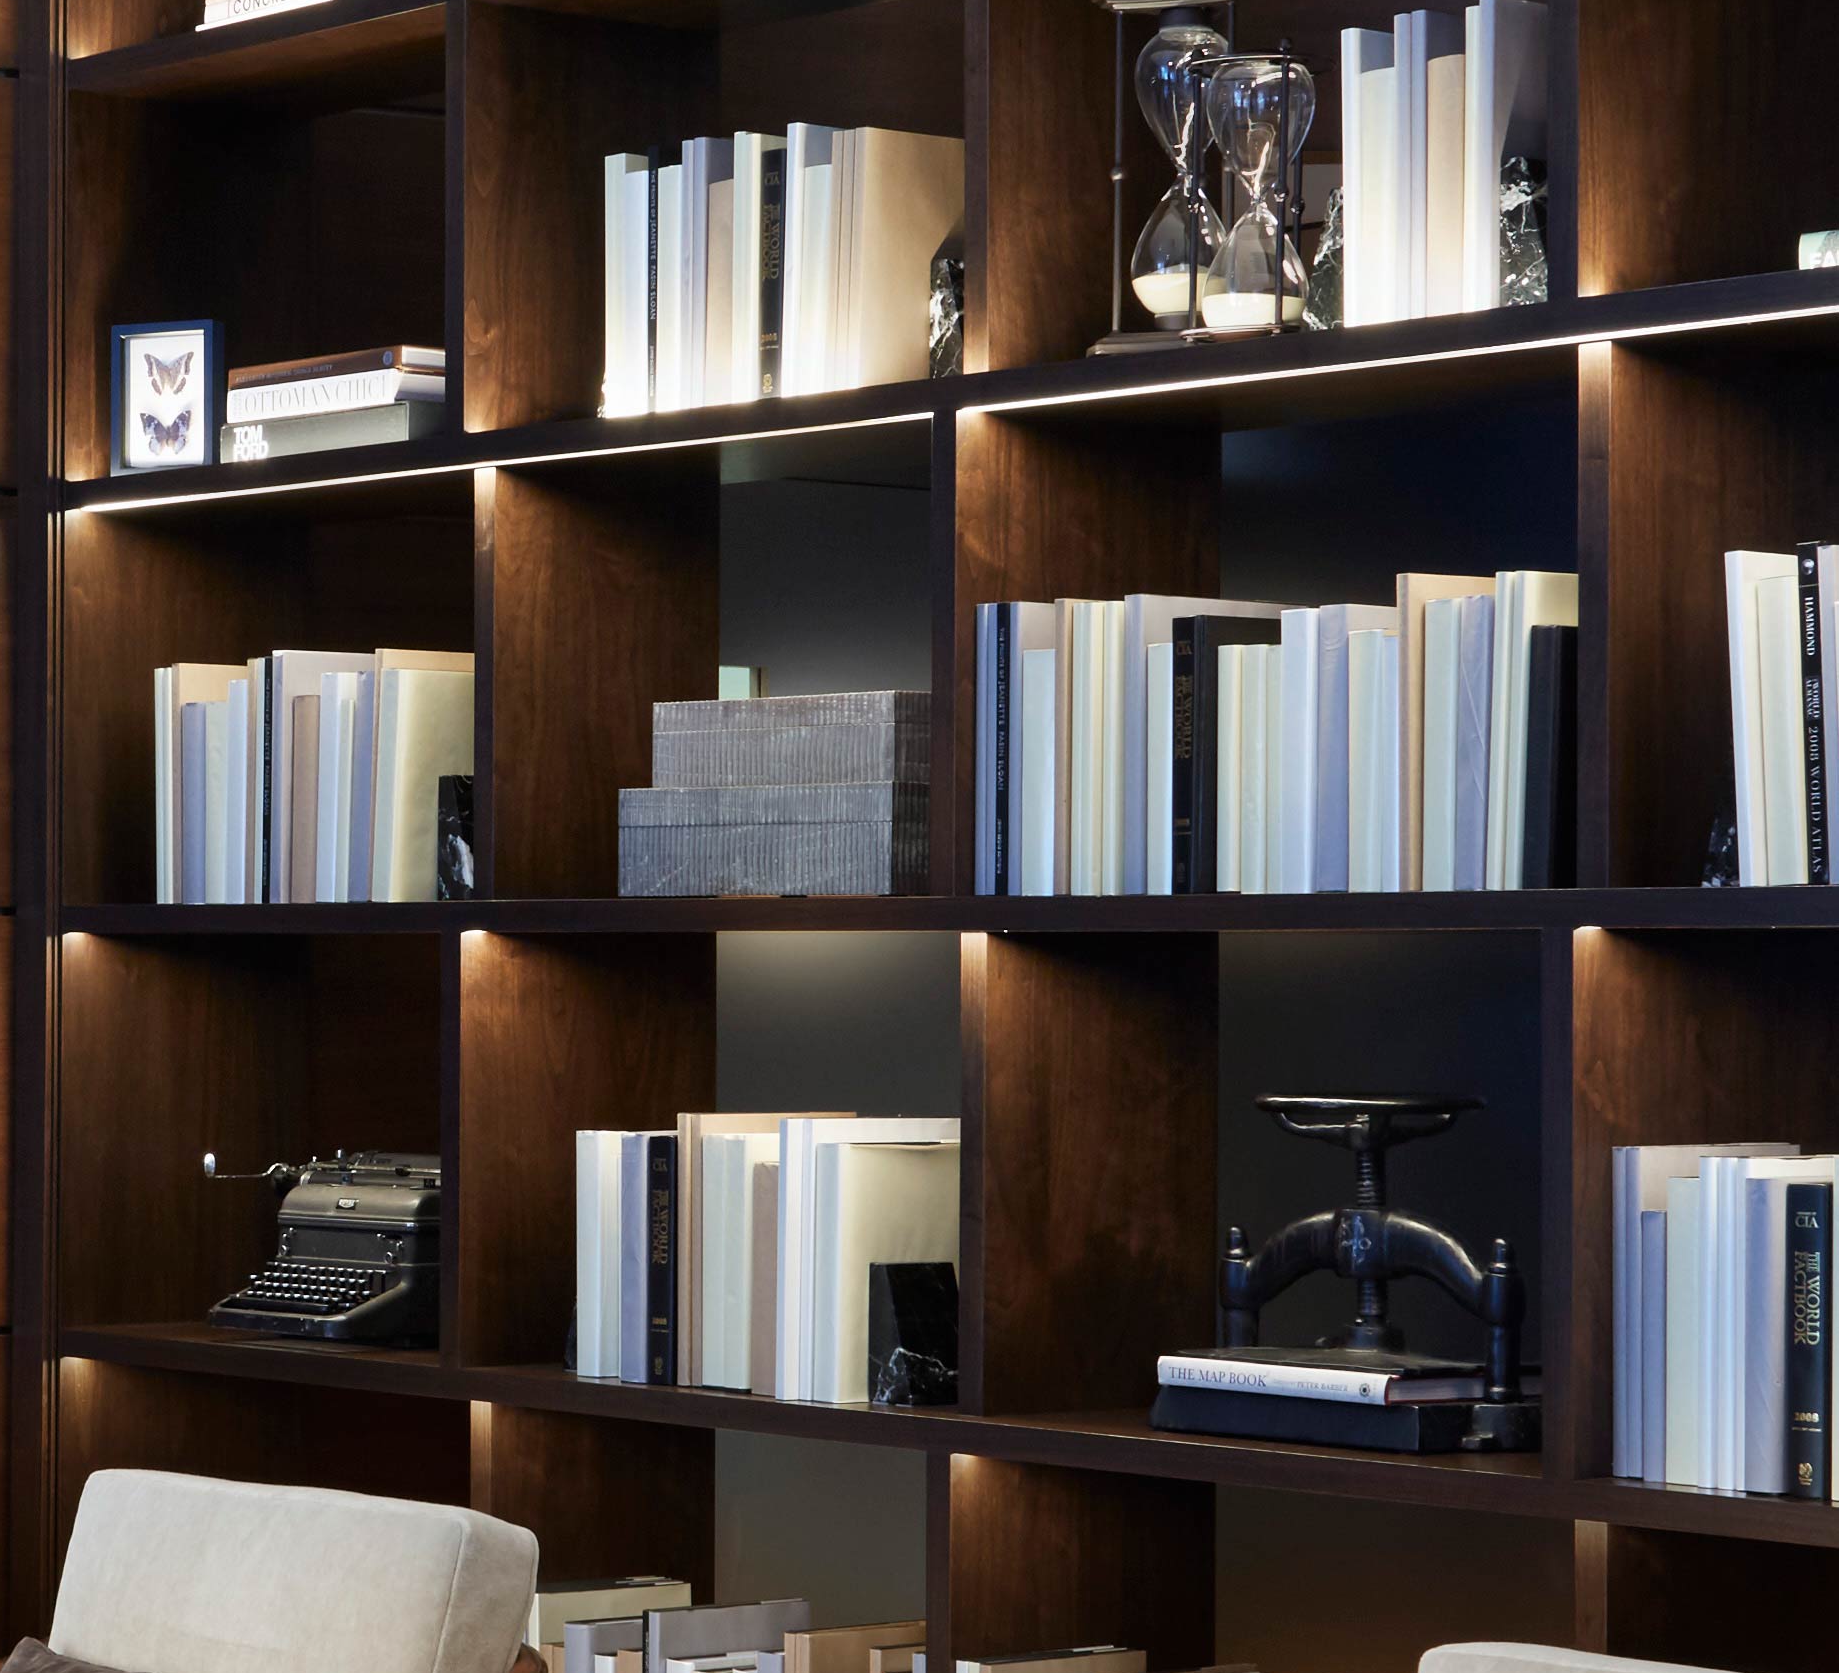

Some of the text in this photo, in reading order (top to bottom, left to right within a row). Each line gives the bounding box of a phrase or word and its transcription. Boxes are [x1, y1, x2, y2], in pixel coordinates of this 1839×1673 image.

[771, 223, 780, 279] WORLD
[245, 384, 331, 414] OTTOMAN
[233, 425, 264, 444] TOM
[233, 442, 269, 462] FORD
[1804, 596, 1815, 656] HAMMOND
[1809, 727, 1823, 873] 2008 WORLD ATLAS
[1795, 1215, 1818, 1228] CIA
[1794, 1251, 1807, 1345] FACTBOOK
[1806, 1252, 1821, 1346] THE WORLD
[1169, 1366, 1195, 1380] THE
[1198, 1369, 1226, 1383] MAP
[1229, 1371, 1267, 1387] BOOK
